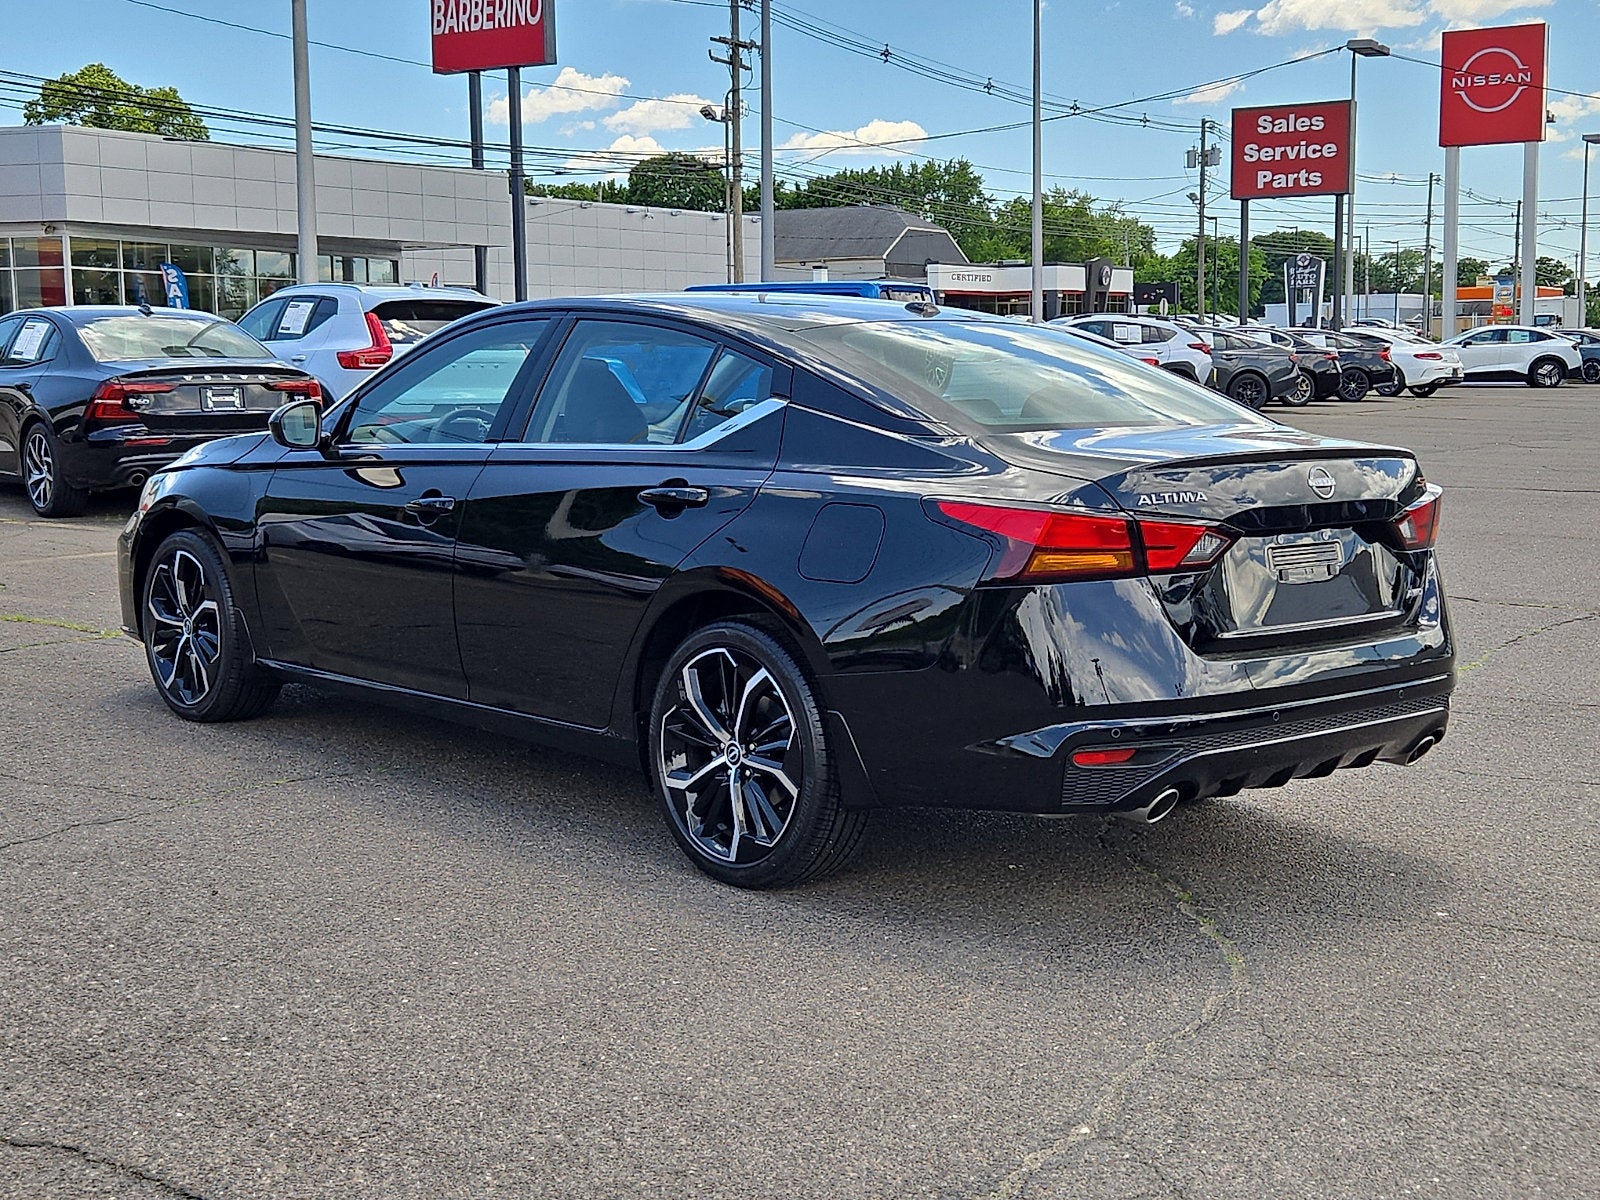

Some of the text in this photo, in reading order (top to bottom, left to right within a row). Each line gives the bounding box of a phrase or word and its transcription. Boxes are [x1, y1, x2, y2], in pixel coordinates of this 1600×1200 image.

[433, 0, 542, 35] BARBERINO
[1452, 72, 1531, 88] NISSAN
[1257, 114, 1325, 134] Sales
[1243, 140, 1338, 162] Service
[1257, 168, 1322, 189] Parts
[951, 273, 992, 282] CERTIFIED
[183, 374, 266, 382] VOLVO
[1138, 491, 1208, 506] ALTIMA
